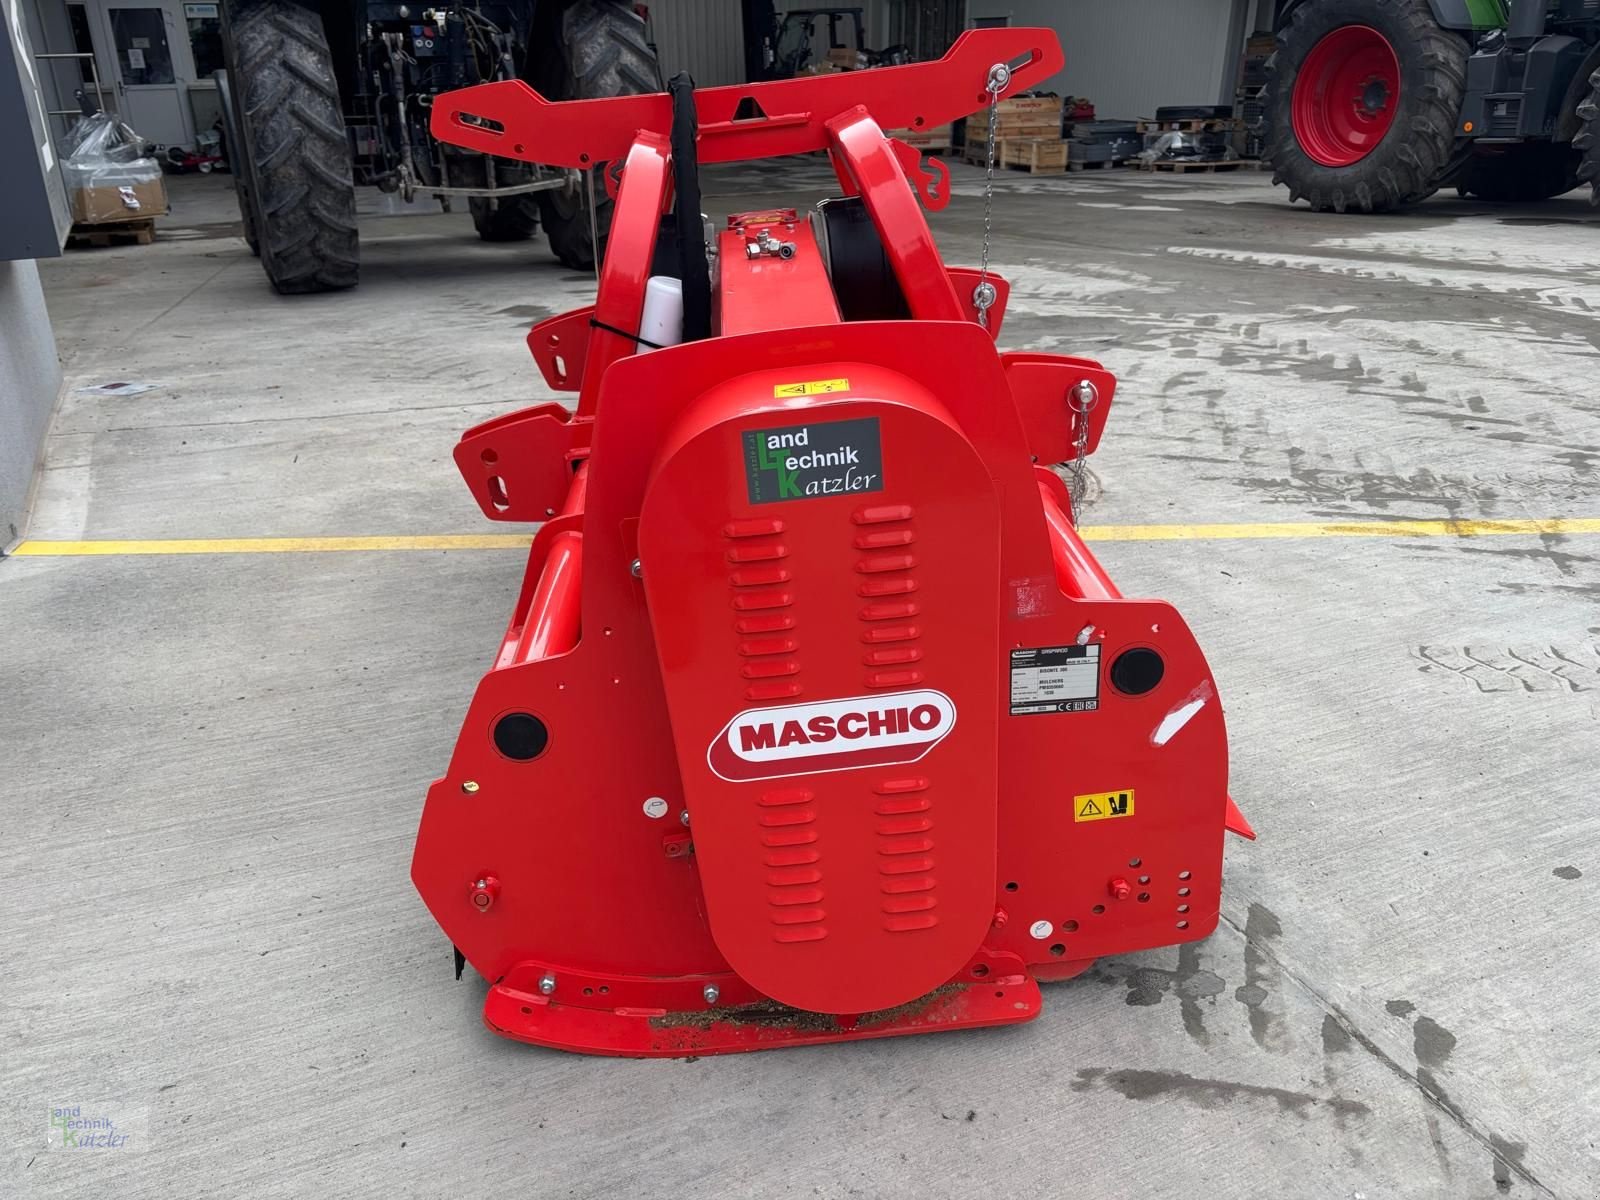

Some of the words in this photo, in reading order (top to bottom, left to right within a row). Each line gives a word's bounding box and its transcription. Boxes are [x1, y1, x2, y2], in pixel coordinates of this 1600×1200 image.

[756, 428, 809, 470] Land
[767, 446, 860, 474] Technik
[780, 466, 877, 498] Katzler
[739, 703, 942, 752] MASCHIO
